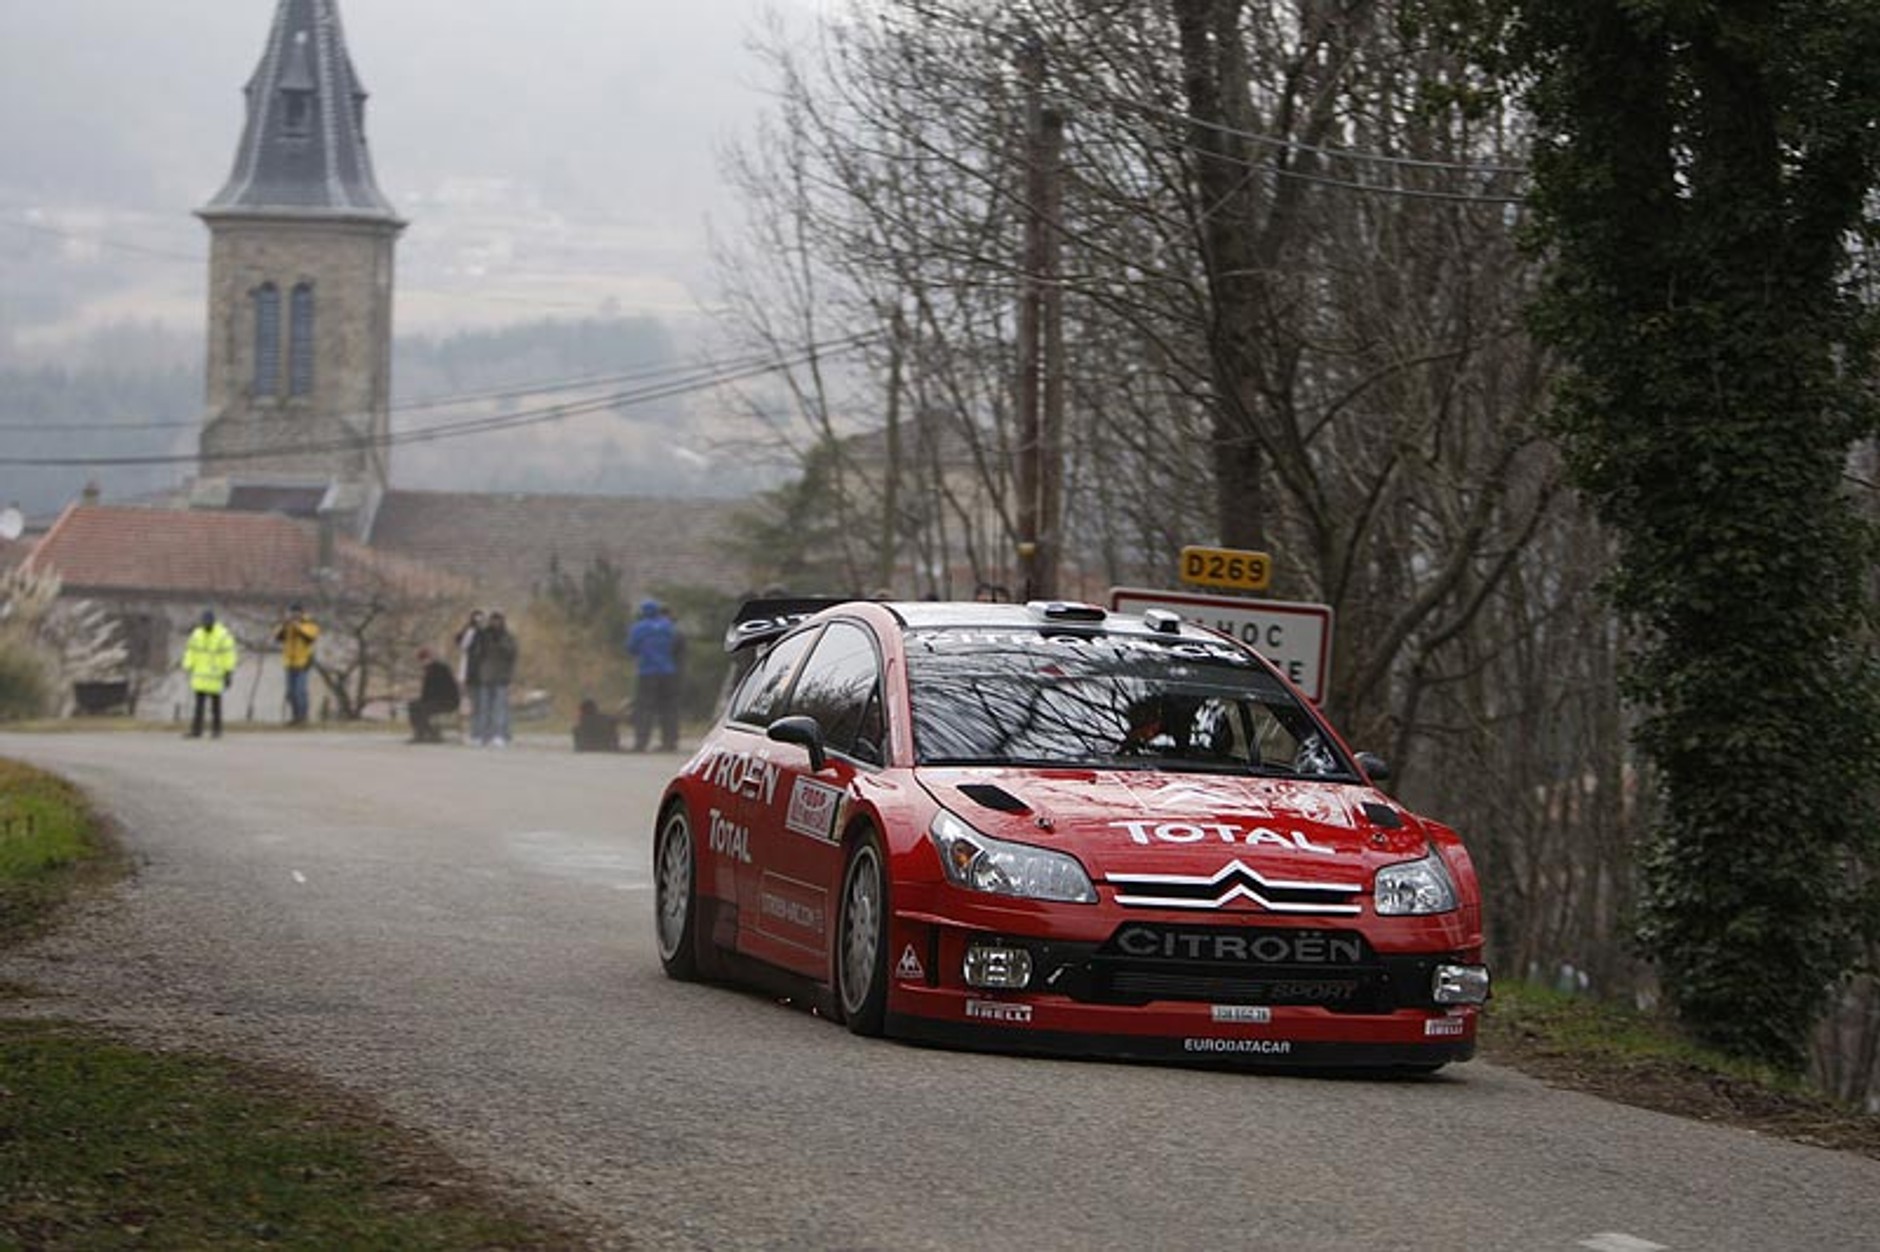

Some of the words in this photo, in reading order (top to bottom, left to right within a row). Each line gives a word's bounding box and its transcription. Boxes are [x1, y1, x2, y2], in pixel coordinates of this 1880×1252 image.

[1187, 554, 1264, 582] D269
[1194, 617, 1282, 647] HOC
[708, 808, 752, 864] TOTAL
[1109, 821, 1336, 854] TOTAL
[1116, 928, 1361, 963] CITROËN
[1272, 980, 1359, 1000] SPORT
[965, 1000, 1033, 1023] PIRELLI
[1184, 1038, 1291, 1054] EURODATACAR
